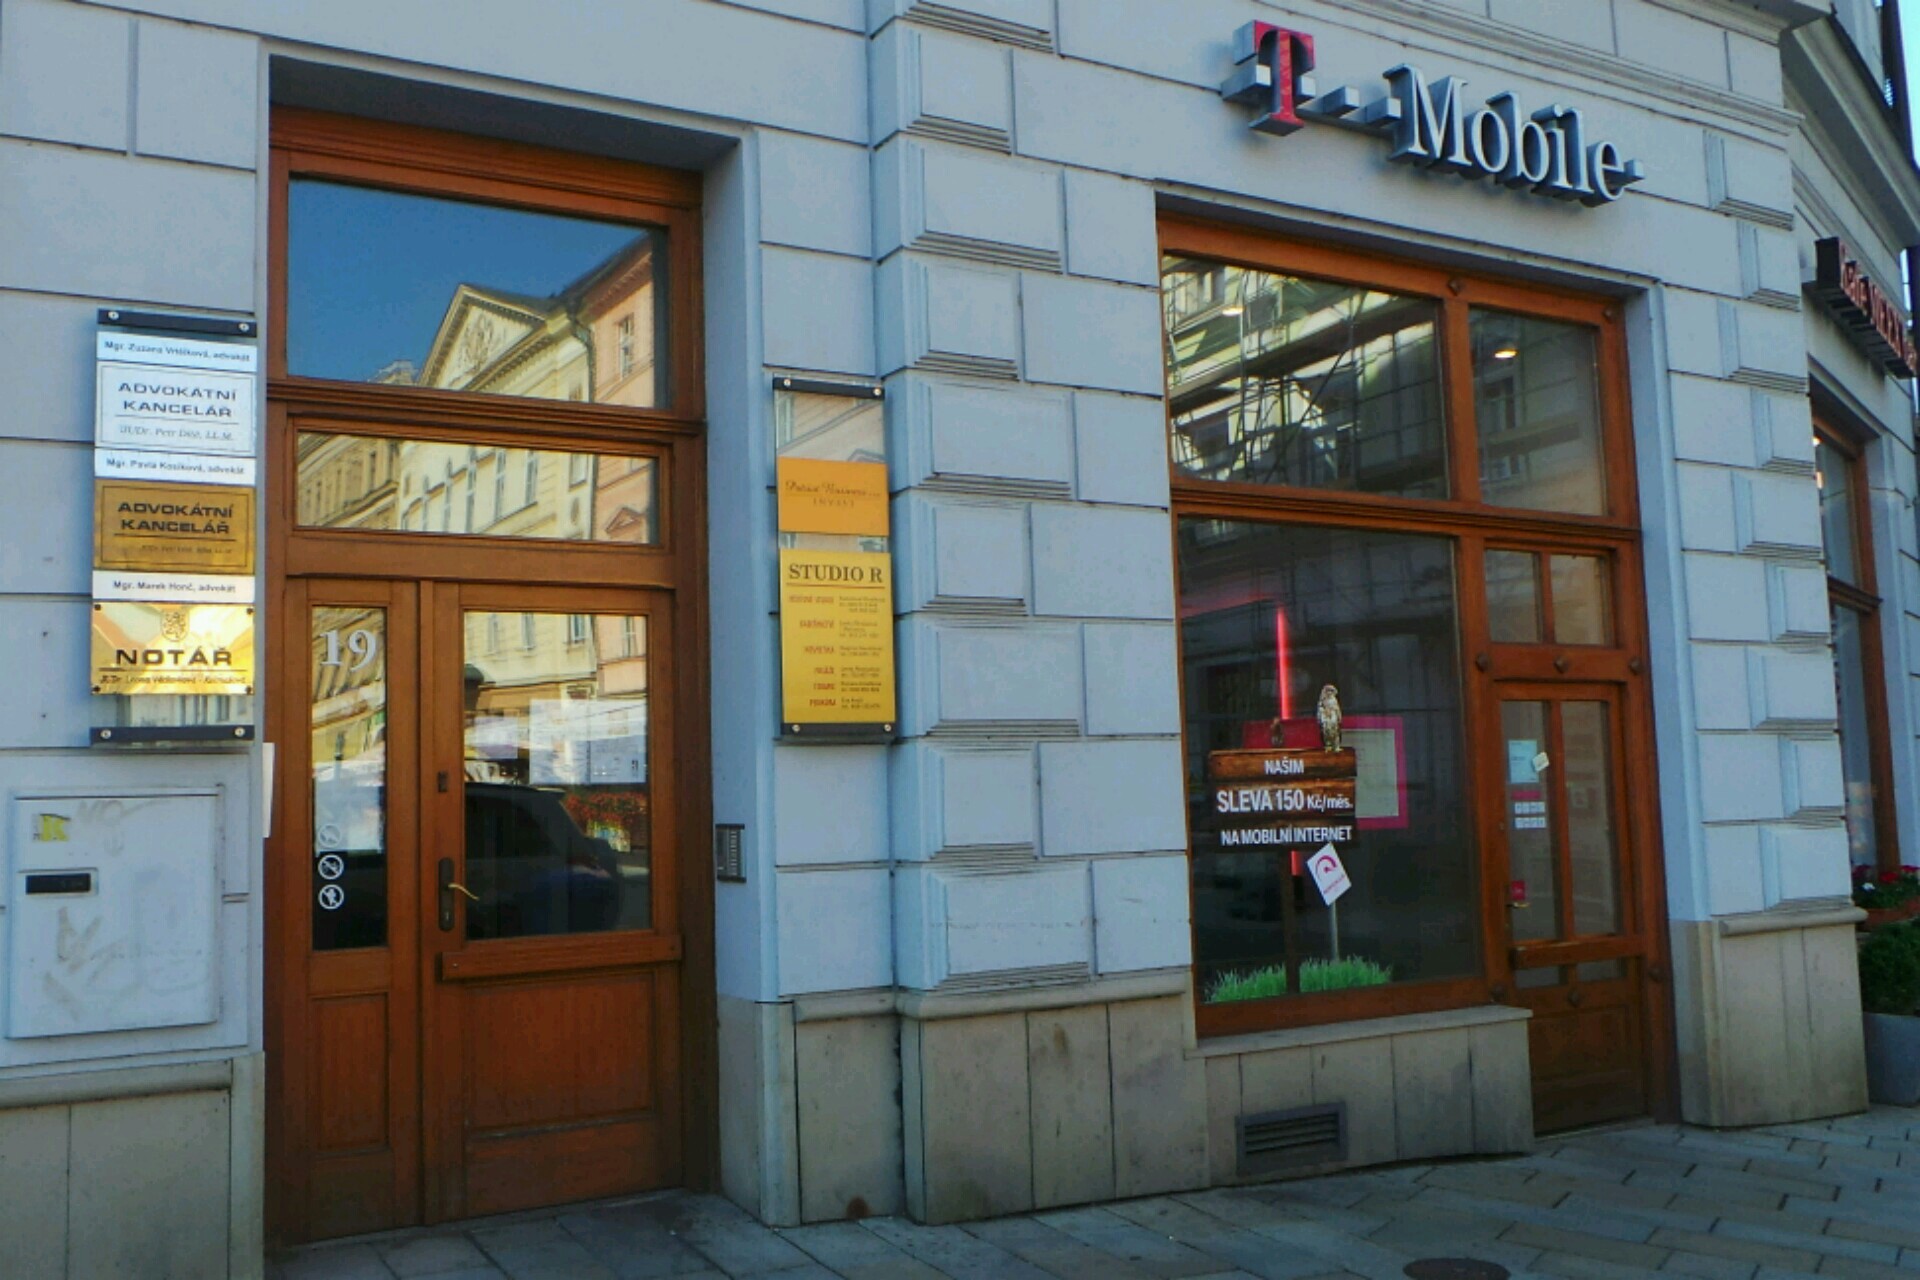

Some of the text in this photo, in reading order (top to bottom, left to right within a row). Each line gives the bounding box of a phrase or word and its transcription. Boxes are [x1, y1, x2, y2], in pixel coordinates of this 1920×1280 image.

[788, 563, 883, 584] STUDIO R
[320, 629, 377, 673] 19
[1264, 756, 1304, 775] NAŠIM
[1216, 789, 1274, 812] SLEVA
[1275, 788, 1305, 811] 150
[1221, 829, 1240, 846] NA
[1293, 825, 1353, 842] INTERNET
